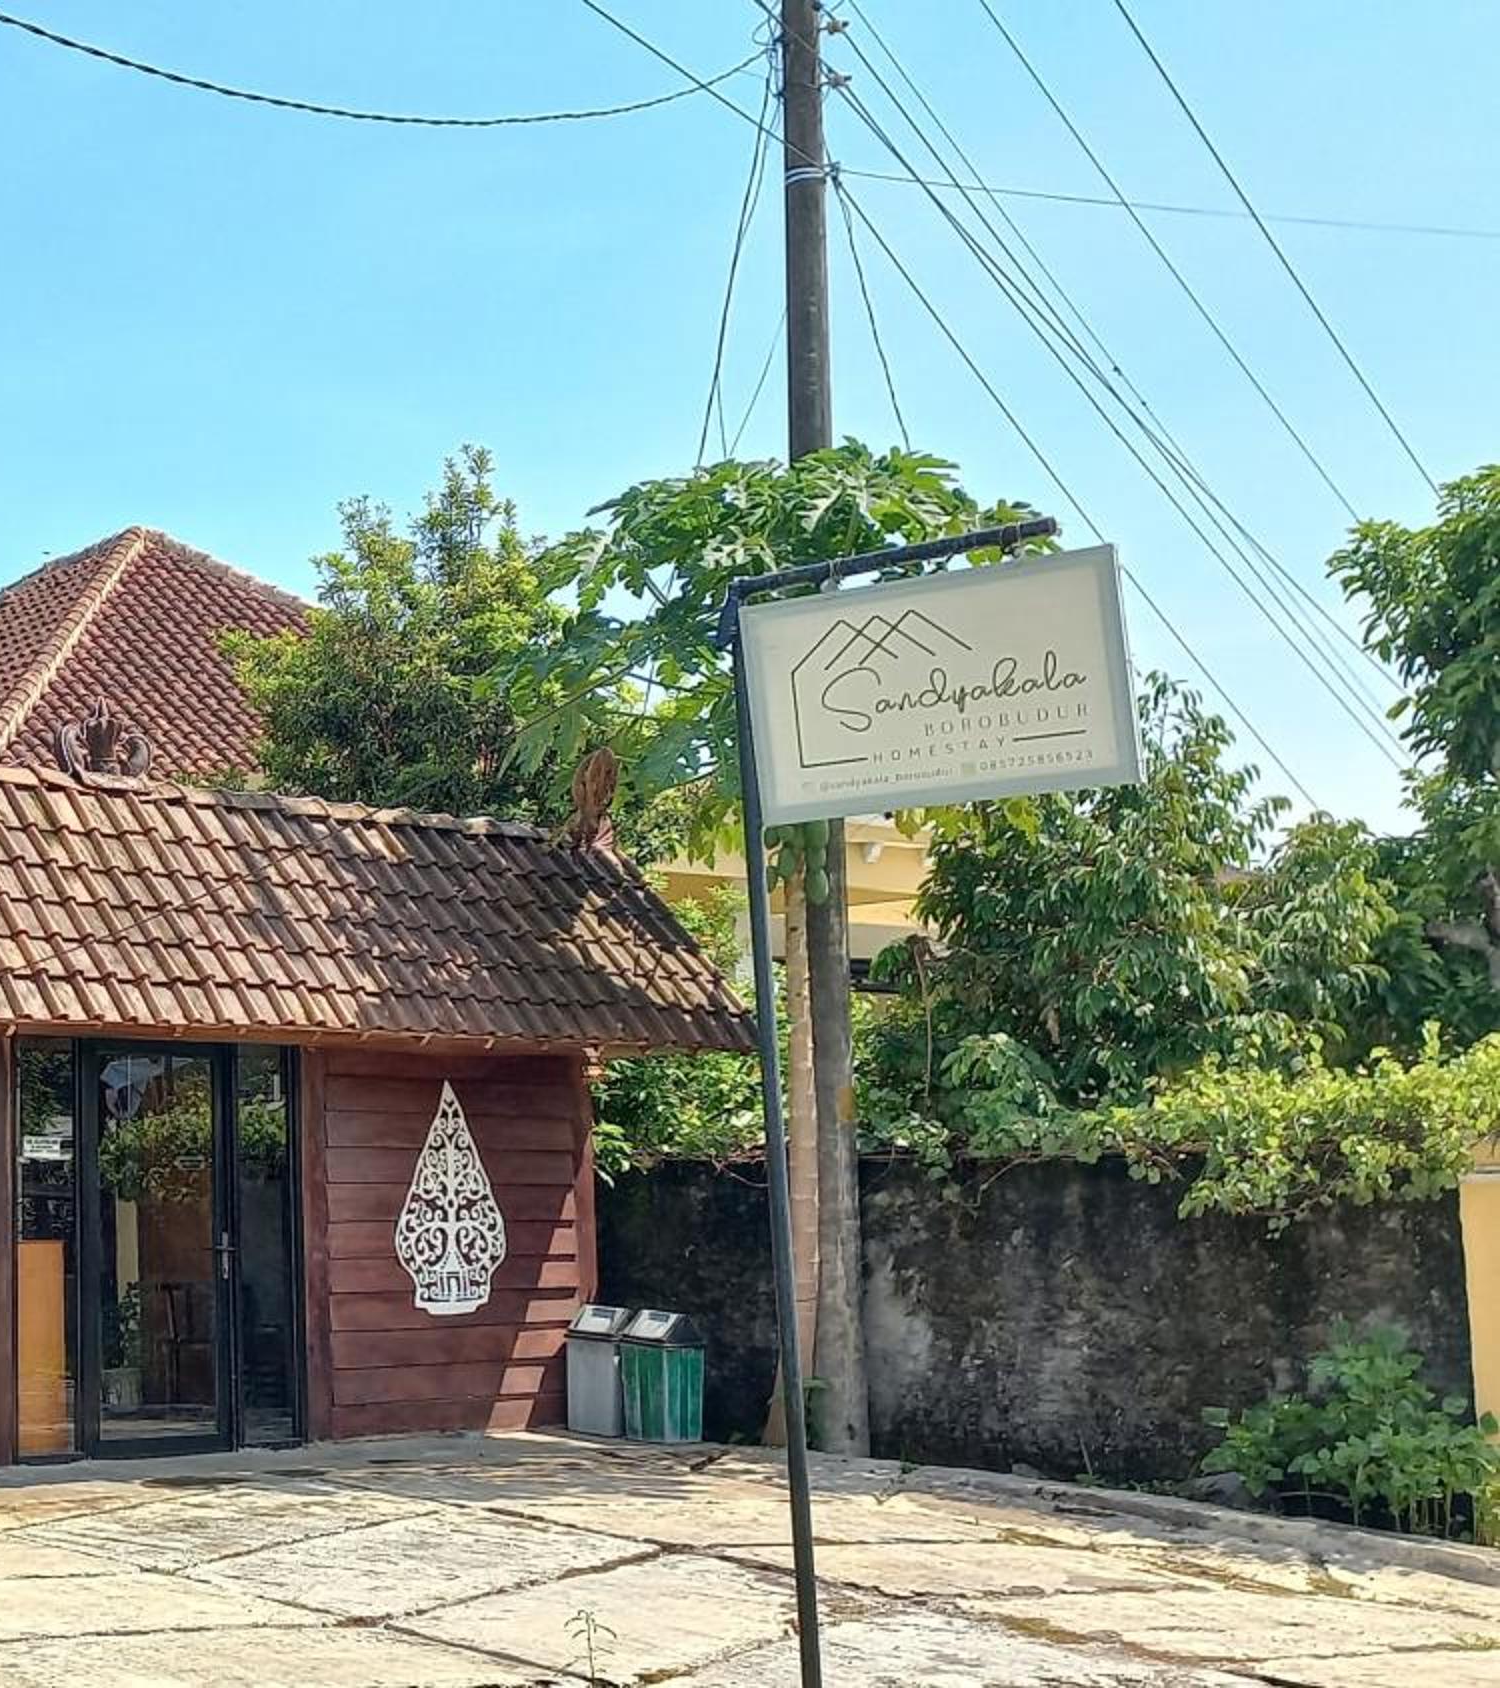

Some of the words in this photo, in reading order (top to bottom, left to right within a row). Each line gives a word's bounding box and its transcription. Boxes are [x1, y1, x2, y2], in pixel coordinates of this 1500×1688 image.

[821, 650, 1088, 732] Sandyakala
[924, 704, 1088, 736] BOROBUDUR
[873, 735, 1006, 763] HOMESTAY
